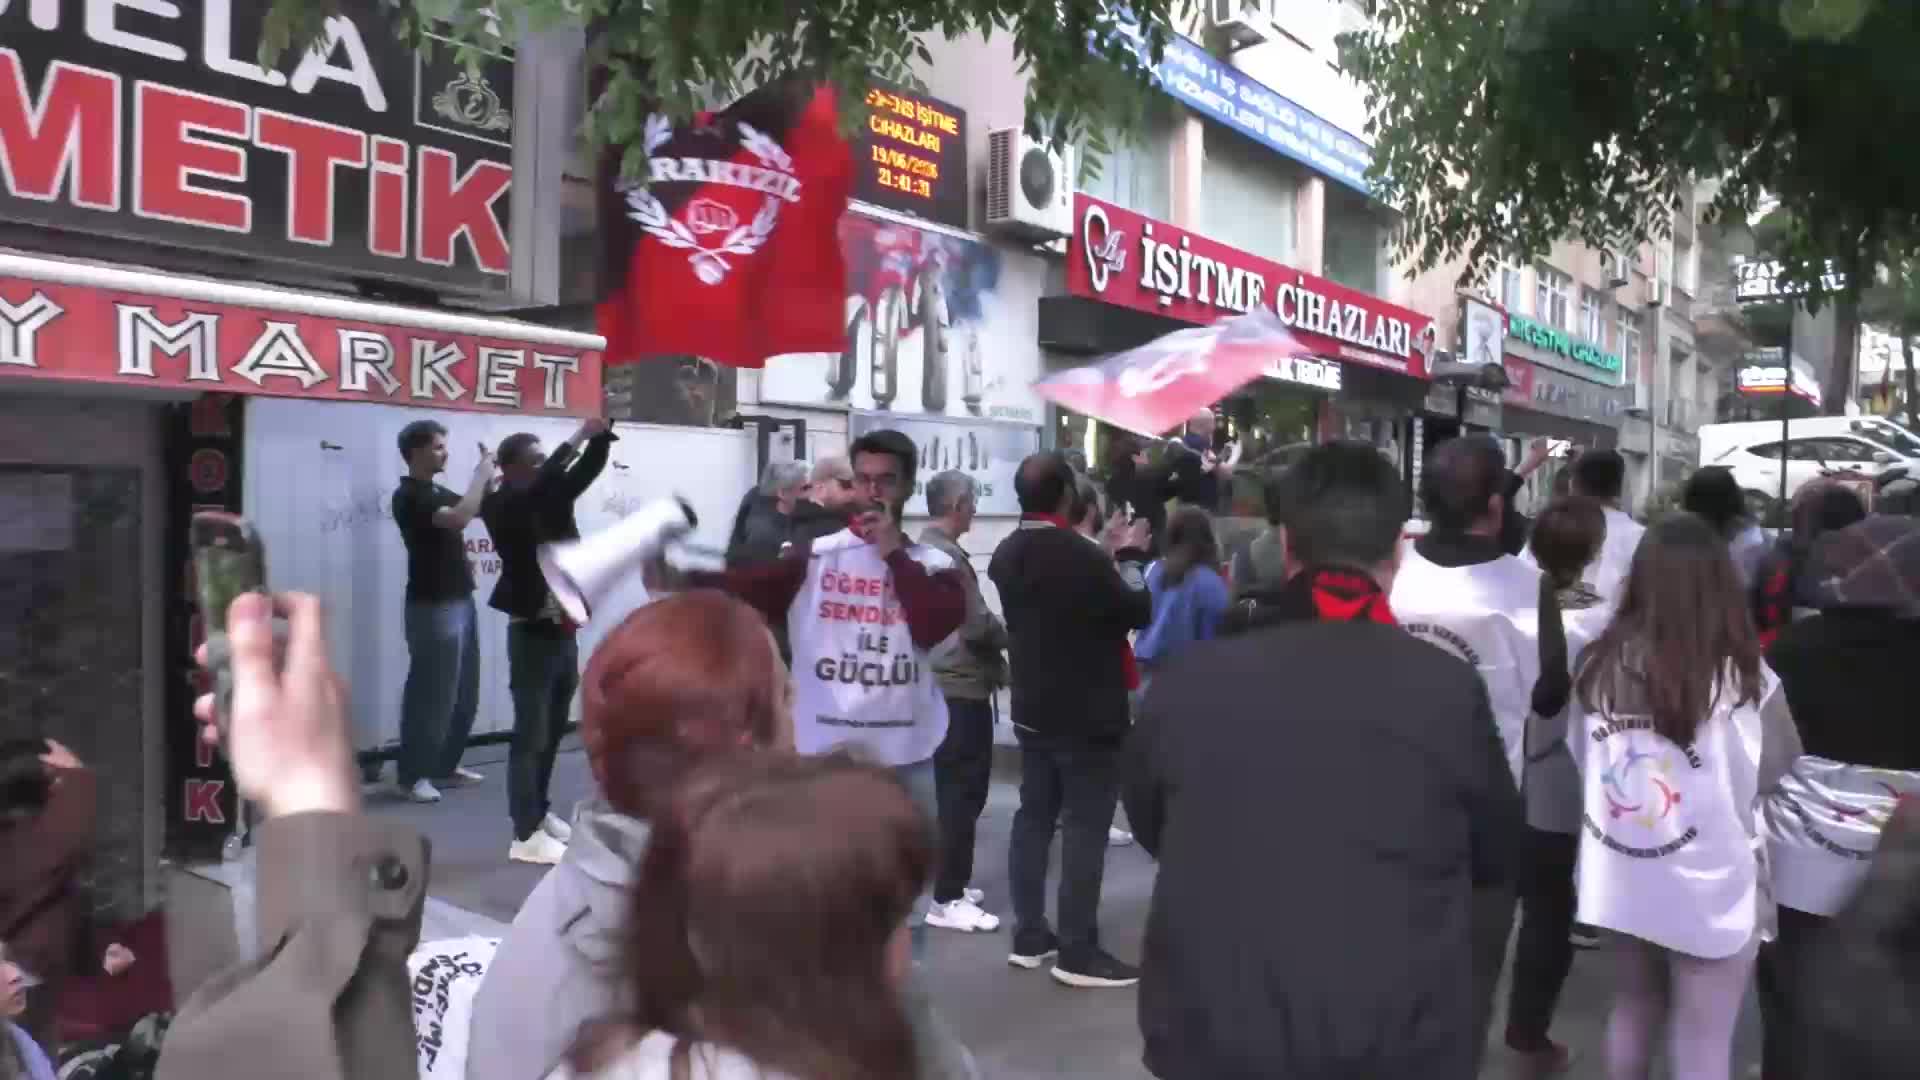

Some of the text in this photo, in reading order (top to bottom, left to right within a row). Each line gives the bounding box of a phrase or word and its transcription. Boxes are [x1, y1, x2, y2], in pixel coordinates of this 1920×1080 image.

[0, 0, 387, 112] ELA
[1141, 223, 1265, 312] İŞİTME
[1276, 274, 1411, 358] CİHAZLARI
[115, 302, 581, 409] MARKET
[820, 568, 891, 597] ÖĞRE
[857, 627, 889, 654] İLE
